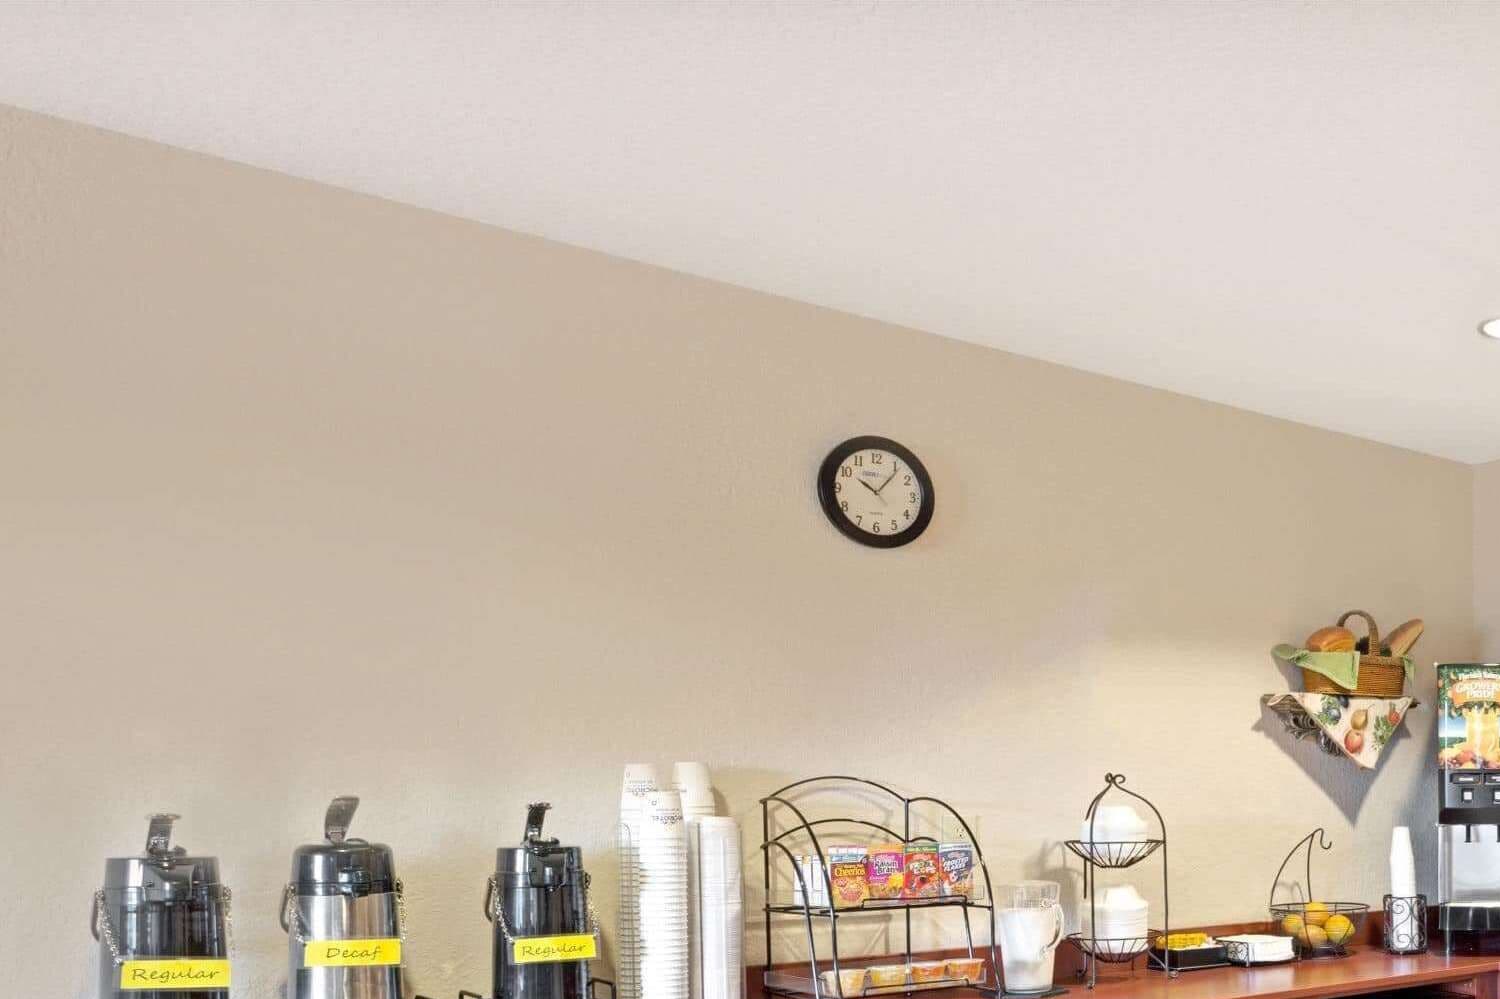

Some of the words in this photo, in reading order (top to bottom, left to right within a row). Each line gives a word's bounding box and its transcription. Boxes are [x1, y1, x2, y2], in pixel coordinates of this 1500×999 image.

[854, 456, 863, 467] 11
[871, 453, 882, 464] 12
[841, 466, 852, 477] 10
[904, 475, 912, 486] 2
[834, 482, 841, 493] 9
[909, 492, 916, 503] 3
[841, 501, 849, 512] 8
[856, 515, 862, 526] 7
[904, 510, 911, 520] 4
[873, 522, 880, 533] 6
[891, 520, 898, 530] 5
[834, 867, 866, 877] Cheerios
[326, 945, 384, 960] Decaf
[521, 943, 586, 958] Regular
[131, 967, 221, 984] Regular
